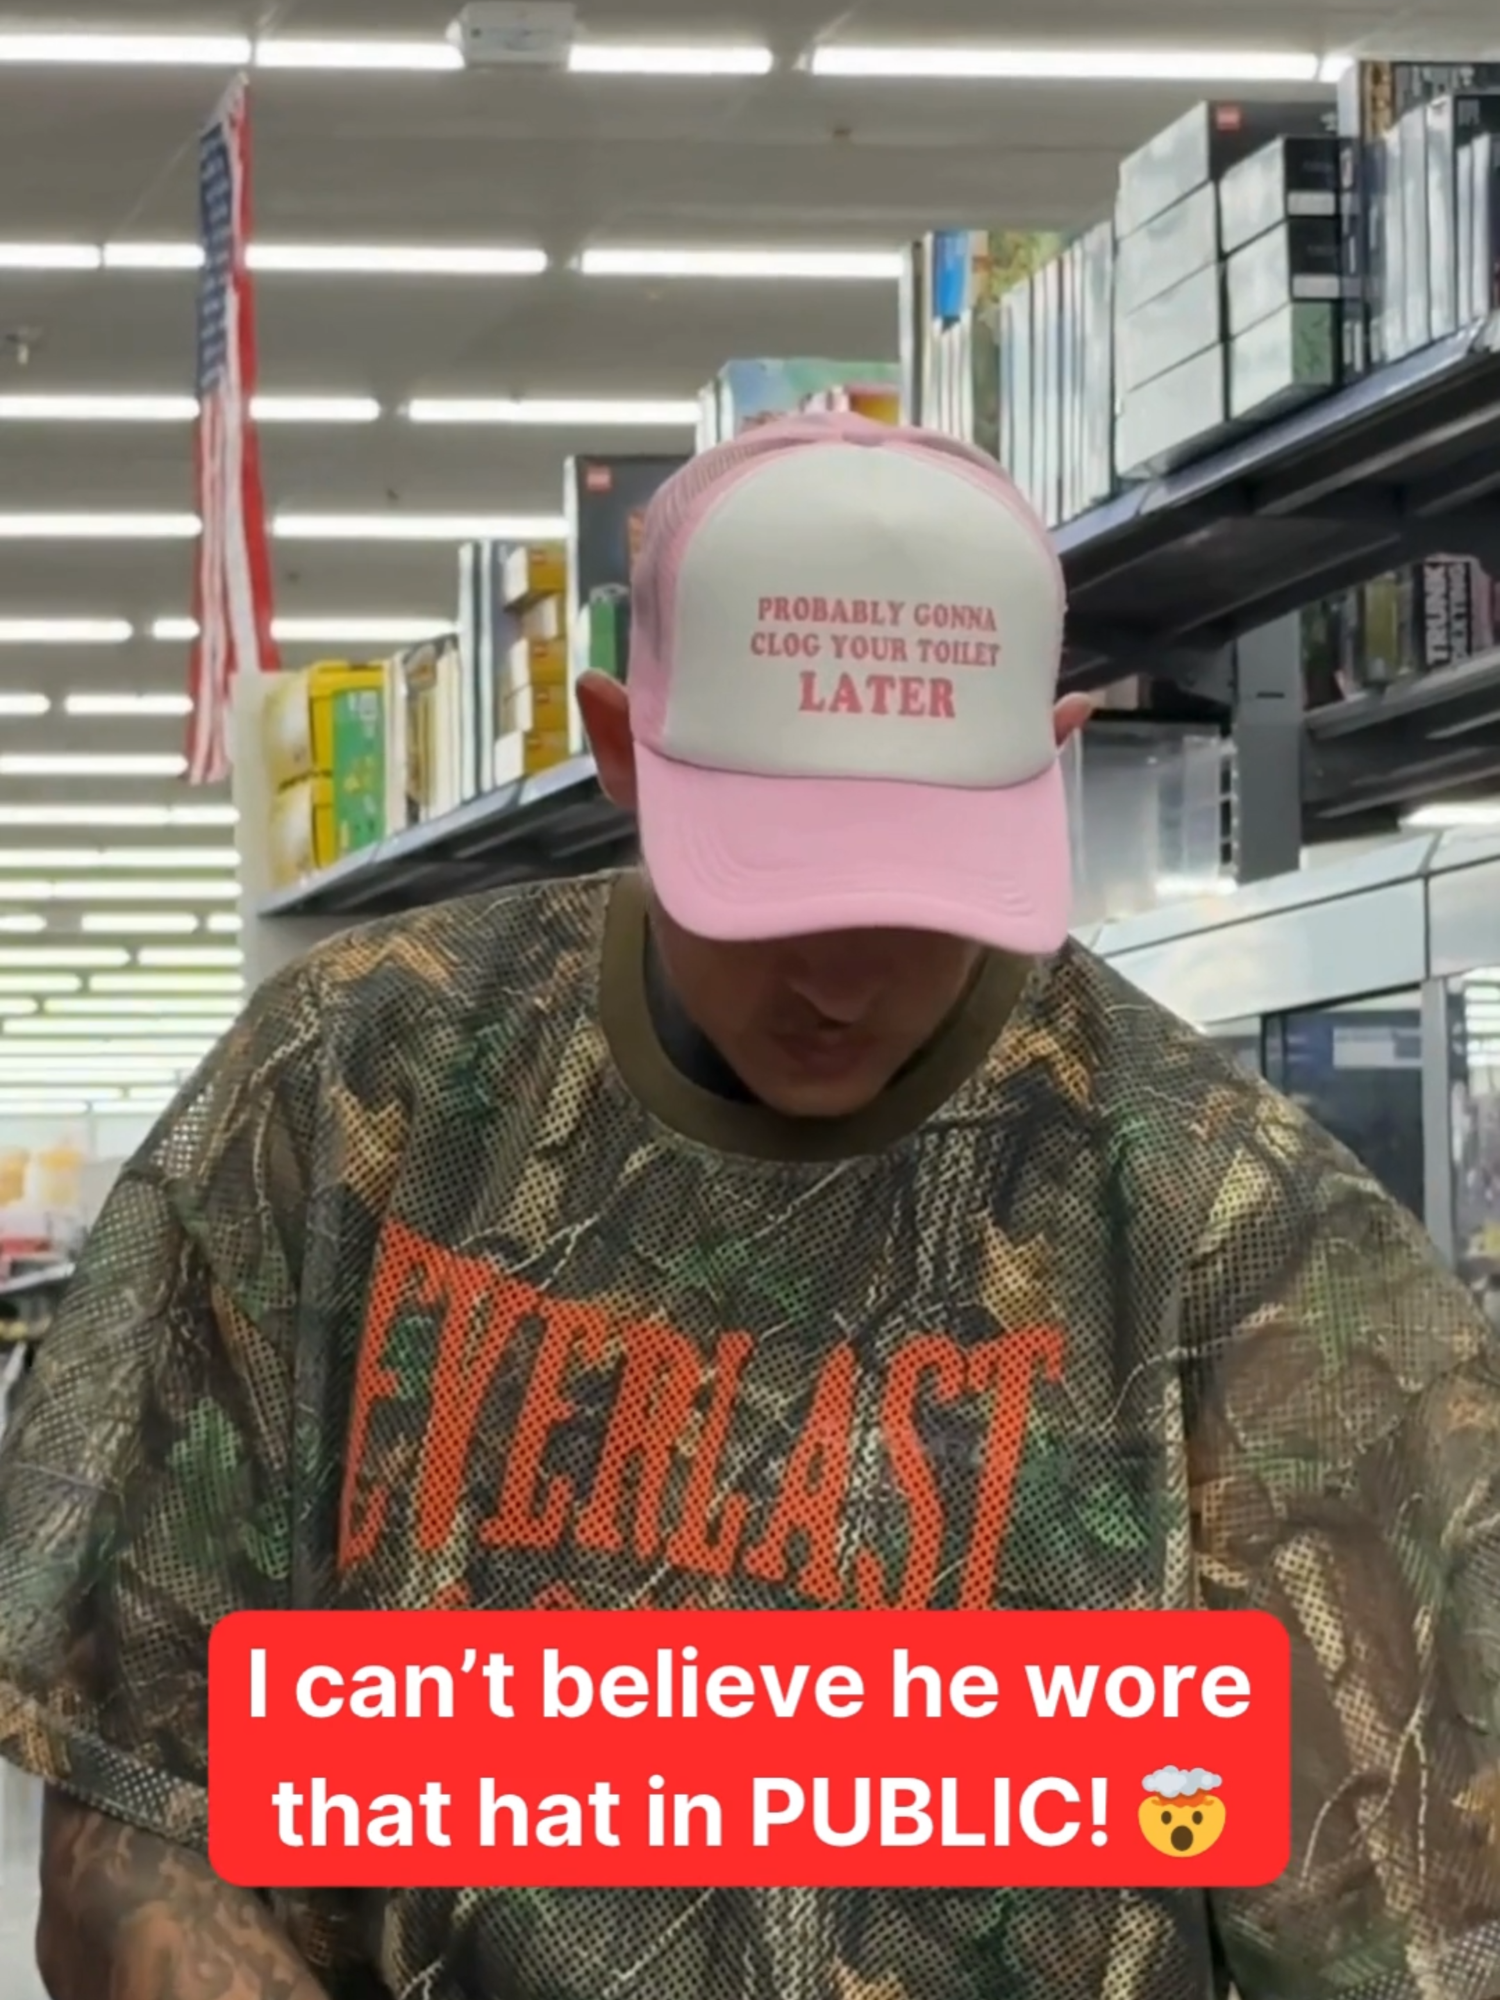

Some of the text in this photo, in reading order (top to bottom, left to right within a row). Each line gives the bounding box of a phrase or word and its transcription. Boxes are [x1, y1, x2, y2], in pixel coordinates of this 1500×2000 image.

[757, 596, 998, 632] PROBABLY GONNA
[1424, 563, 1448, 665] TRUNK
[750, 631, 1001, 667] CLOG YOUR TOILET
[797, 670, 956, 719] LATER
[338, 1214, 1065, 1611] EVERLAST
